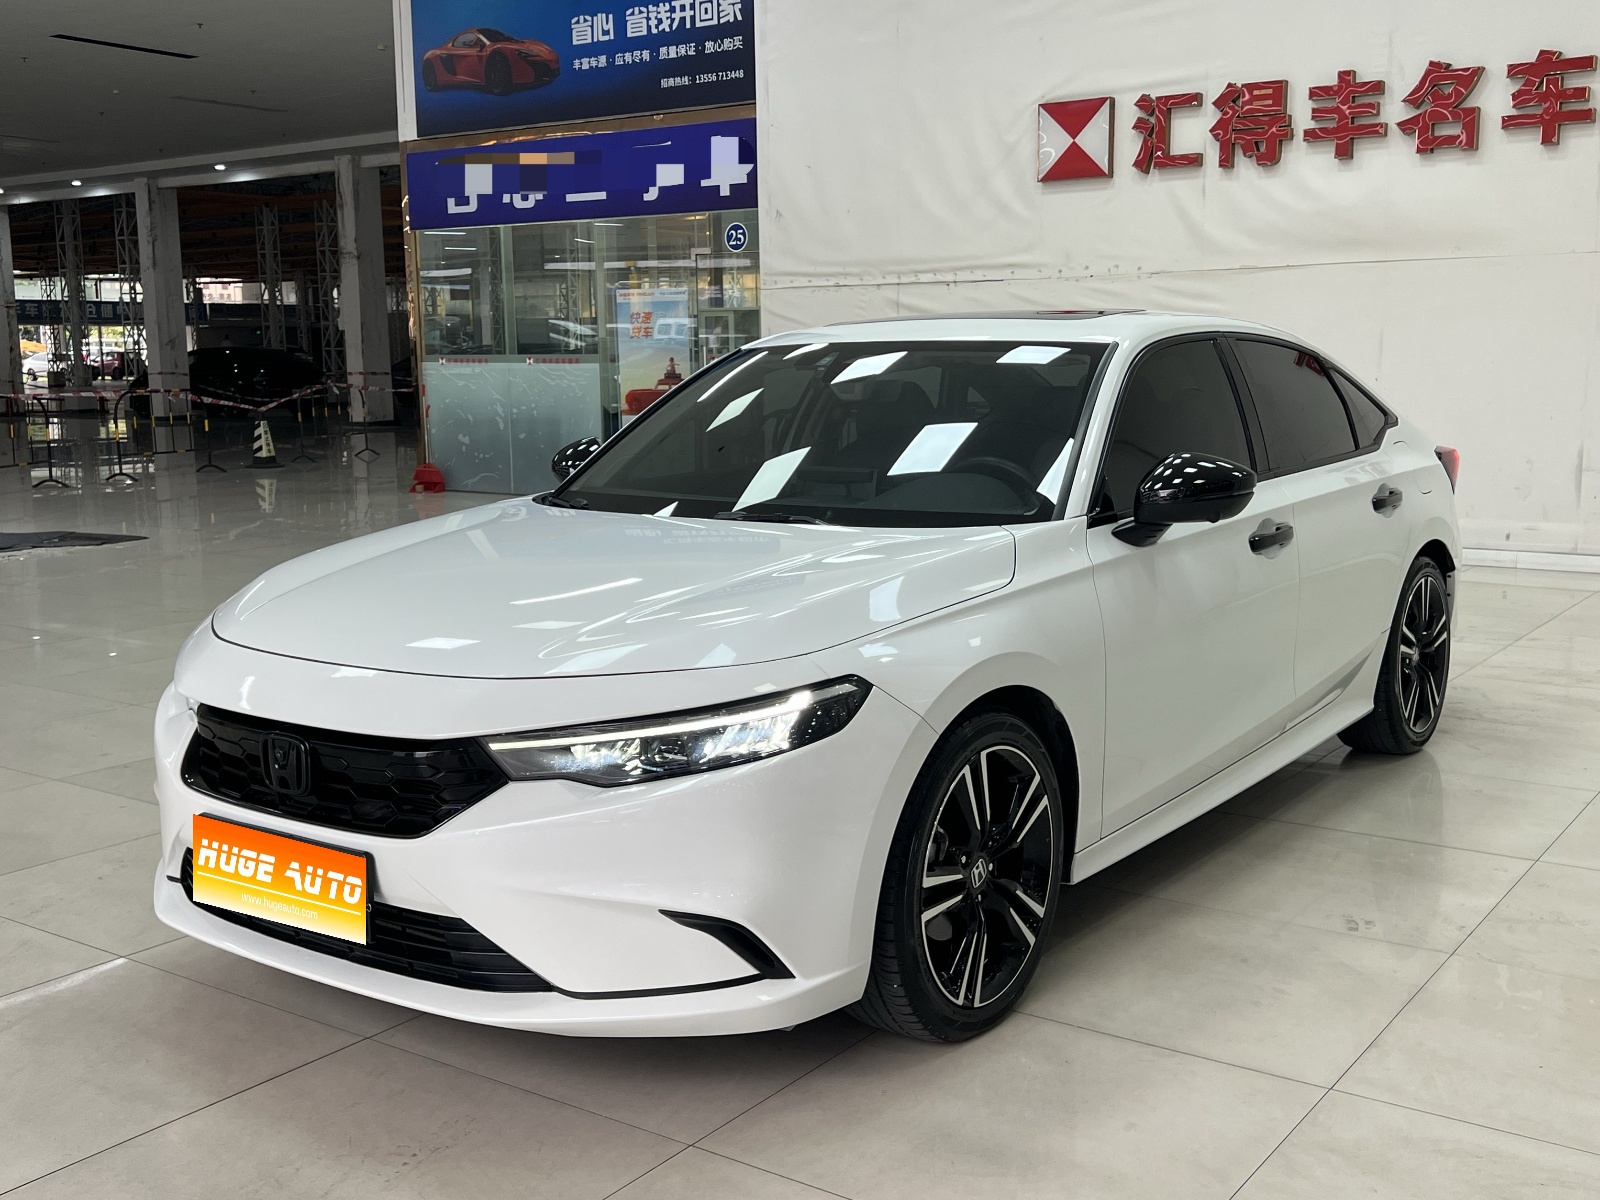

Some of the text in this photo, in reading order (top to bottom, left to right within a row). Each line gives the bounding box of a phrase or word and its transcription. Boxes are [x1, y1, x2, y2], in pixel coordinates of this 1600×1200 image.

[571, 0, 743, 46] 省心 省钱开回家
[572, 36, 743, 71] 丰富车源 应有尽有 质量保证 放心购买
[695, 72, 717, 84] 13556
[718, 69, 744, 81] 713448
[1131, 49, 1597, 175] 汇得丰名车
[728, 229, 745, 245] 25
[629, 311, 653, 325] 快速
